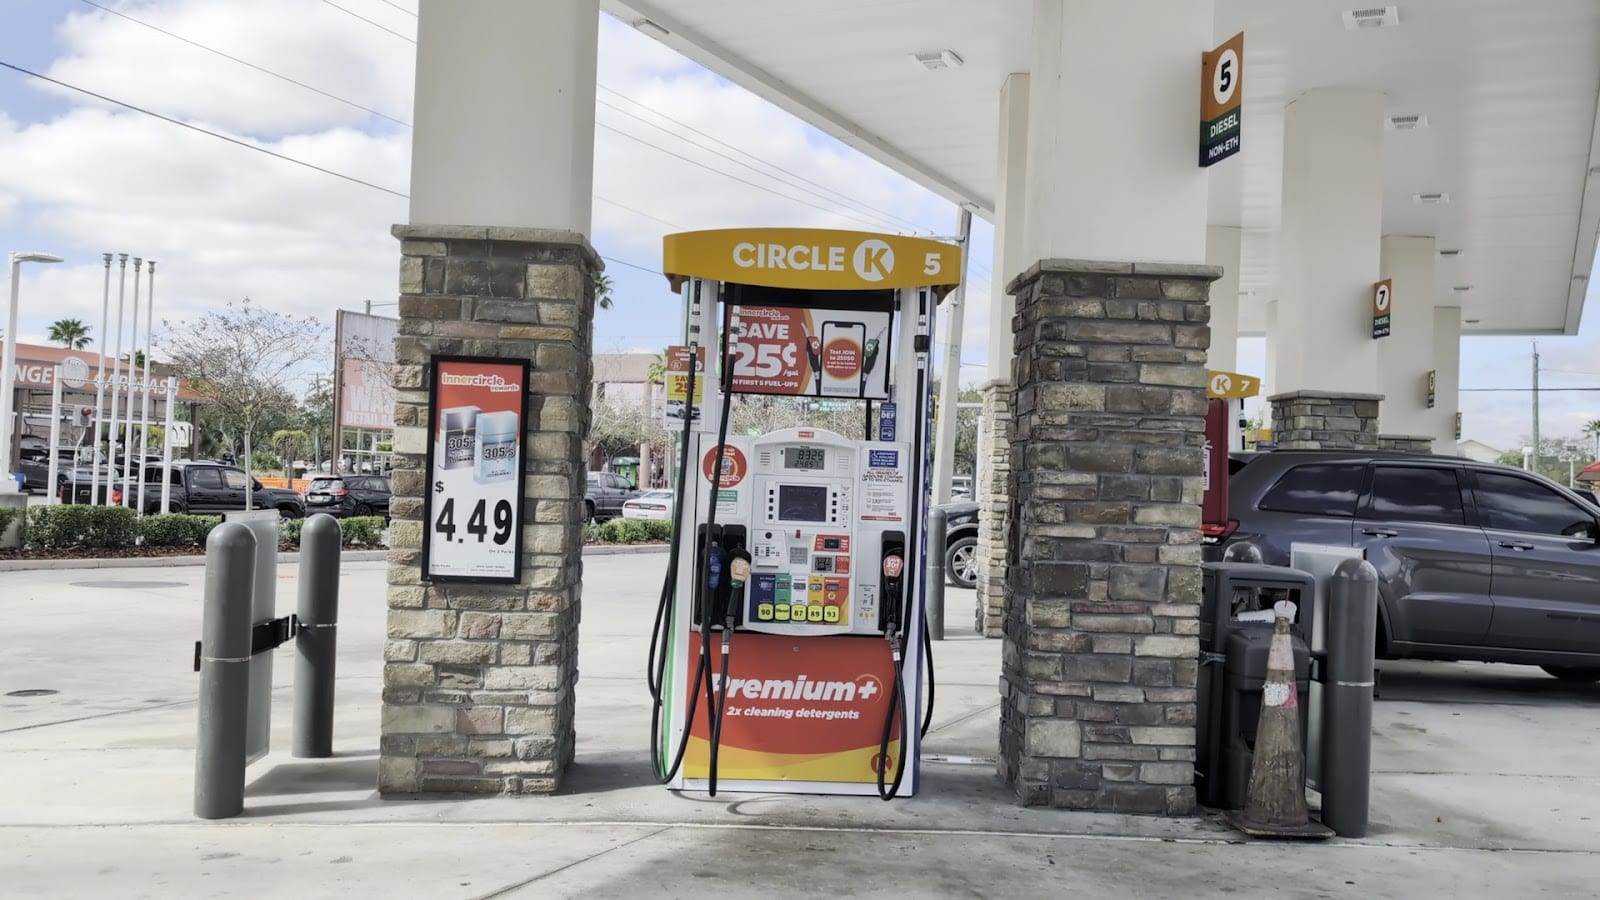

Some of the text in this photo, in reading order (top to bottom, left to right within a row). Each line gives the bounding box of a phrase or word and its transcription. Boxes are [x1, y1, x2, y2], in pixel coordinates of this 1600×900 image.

[1219, 59, 1231, 93] 5
[1210, 112, 1239, 138] DIESEL
[1208, 135, 1239, 160] NON-ETH
[732, 242, 941, 280] CIRCLE K 5
[1379, 290, 1386, 305] 7
[739, 308, 781, 317] nnercircle
[1374, 317, 1389, 326] DIESEL
[738, 322, 789, 340] SAVE
[14, 364, 53, 384] NGE
[442, 372, 506, 387] innercircle
[783, 369, 799, 377] /gal
[490, 383, 520, 392] rewards
[764, 379, 799, 387] FUEL-UPS
[1240, 380, 1250, 391] 7
[881, 411, 895, 419] DEF
[484, 446, 516, 460] 305's
[435, 481, 444, 493] $
[435, 497, 513, 545] 4.49
[760, 608, 771, 616] 90
[794, 609, 804, 617] 87
[726, 706, 860, 720] 2x cleaning detergents
